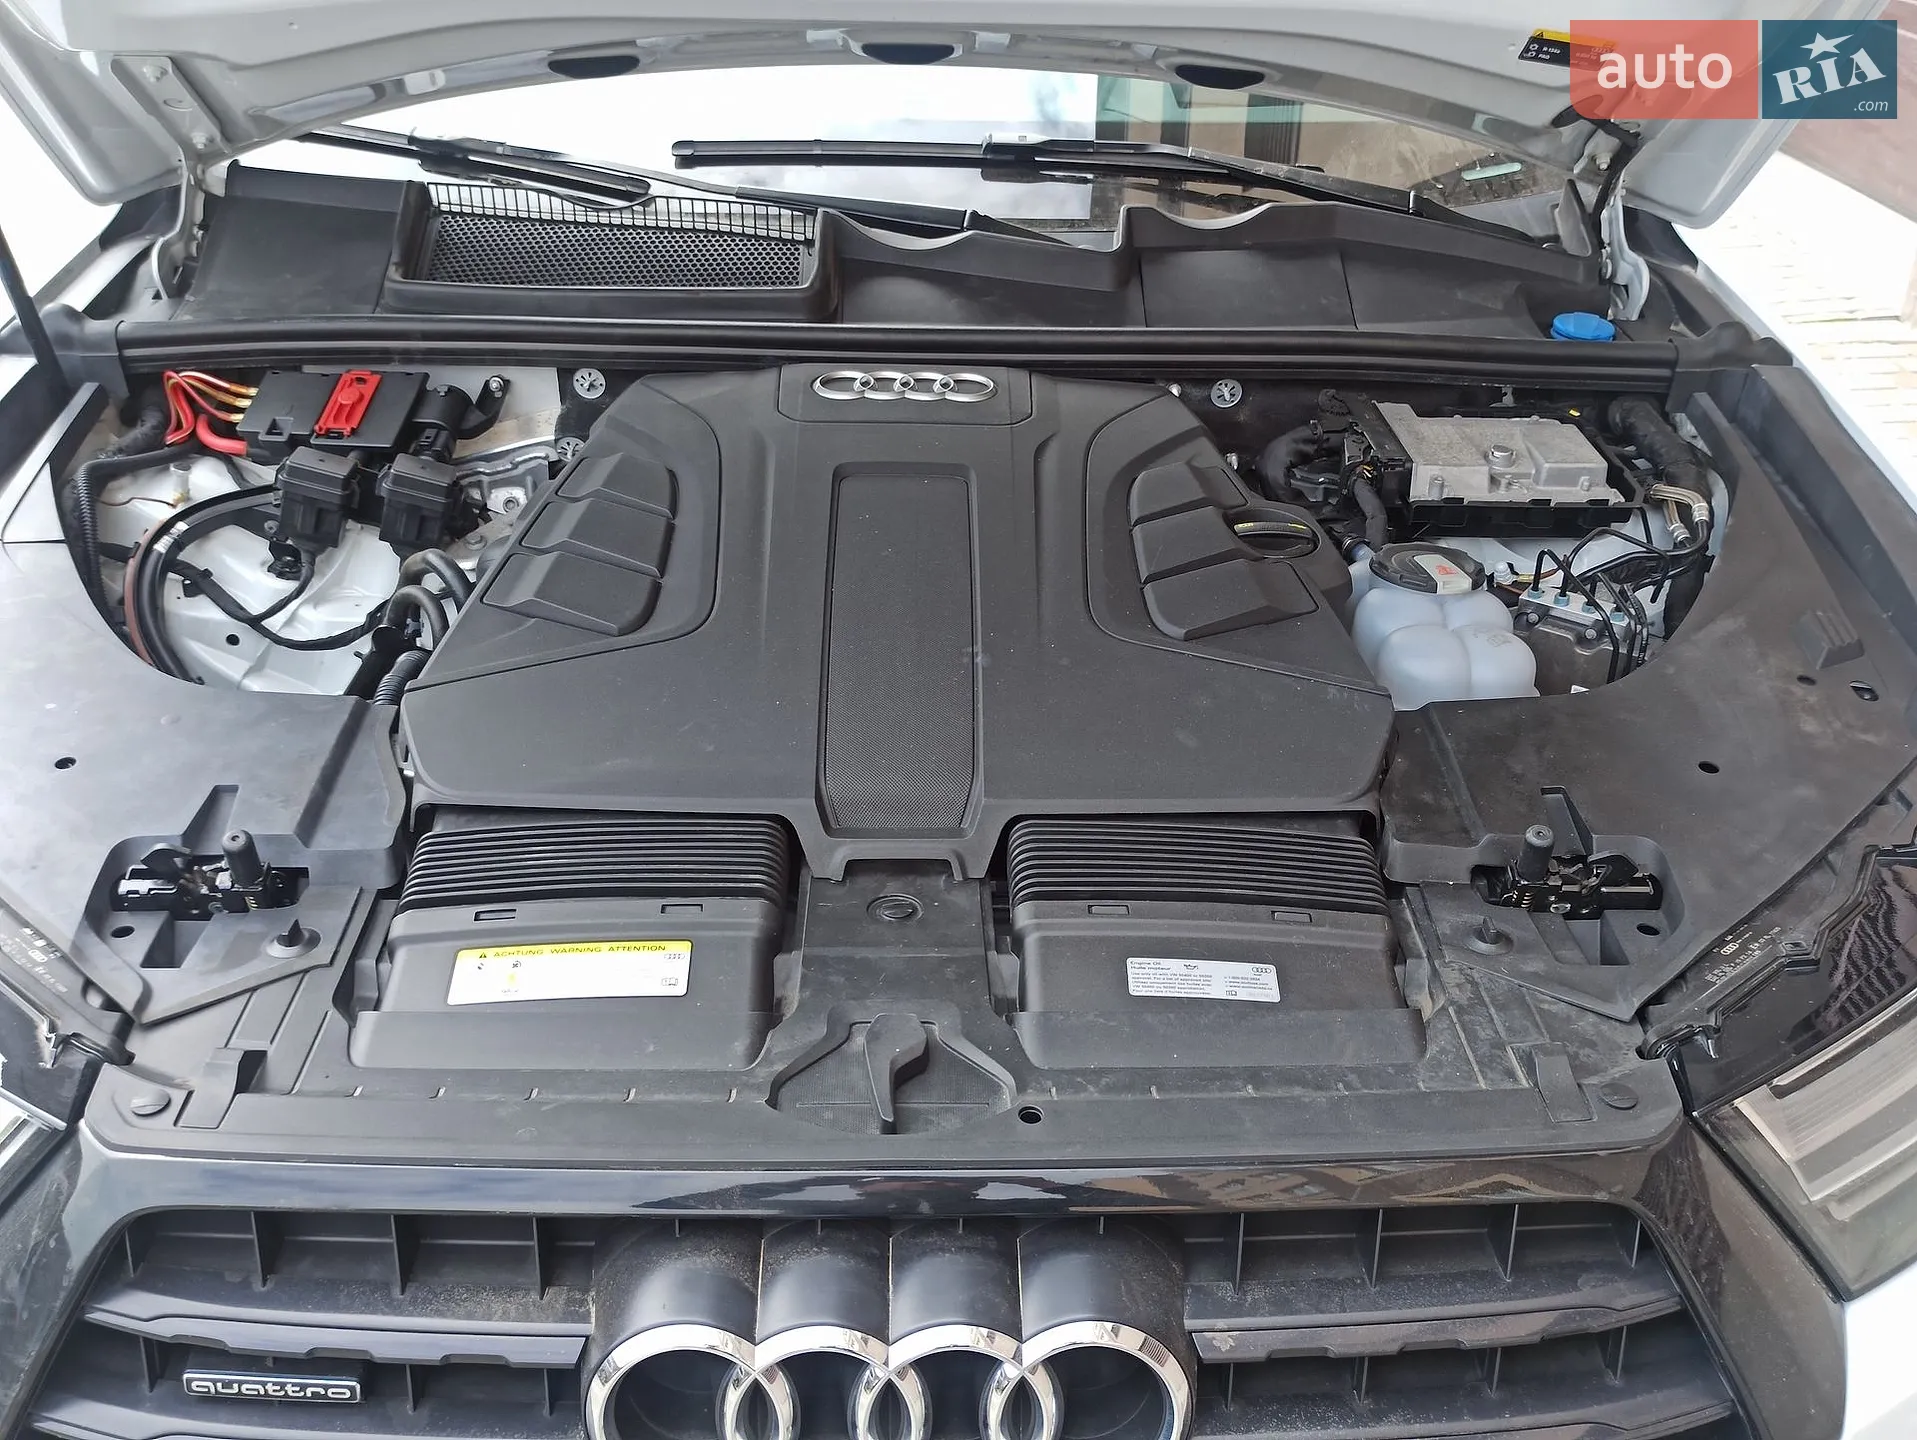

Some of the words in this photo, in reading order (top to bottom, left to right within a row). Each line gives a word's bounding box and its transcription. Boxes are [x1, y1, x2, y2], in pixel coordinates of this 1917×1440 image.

[493, 949, 544, 957] ACHTUNG
[550, 946, 602, 955] WARNING
[190, 1380, 351, 1399] quattro
